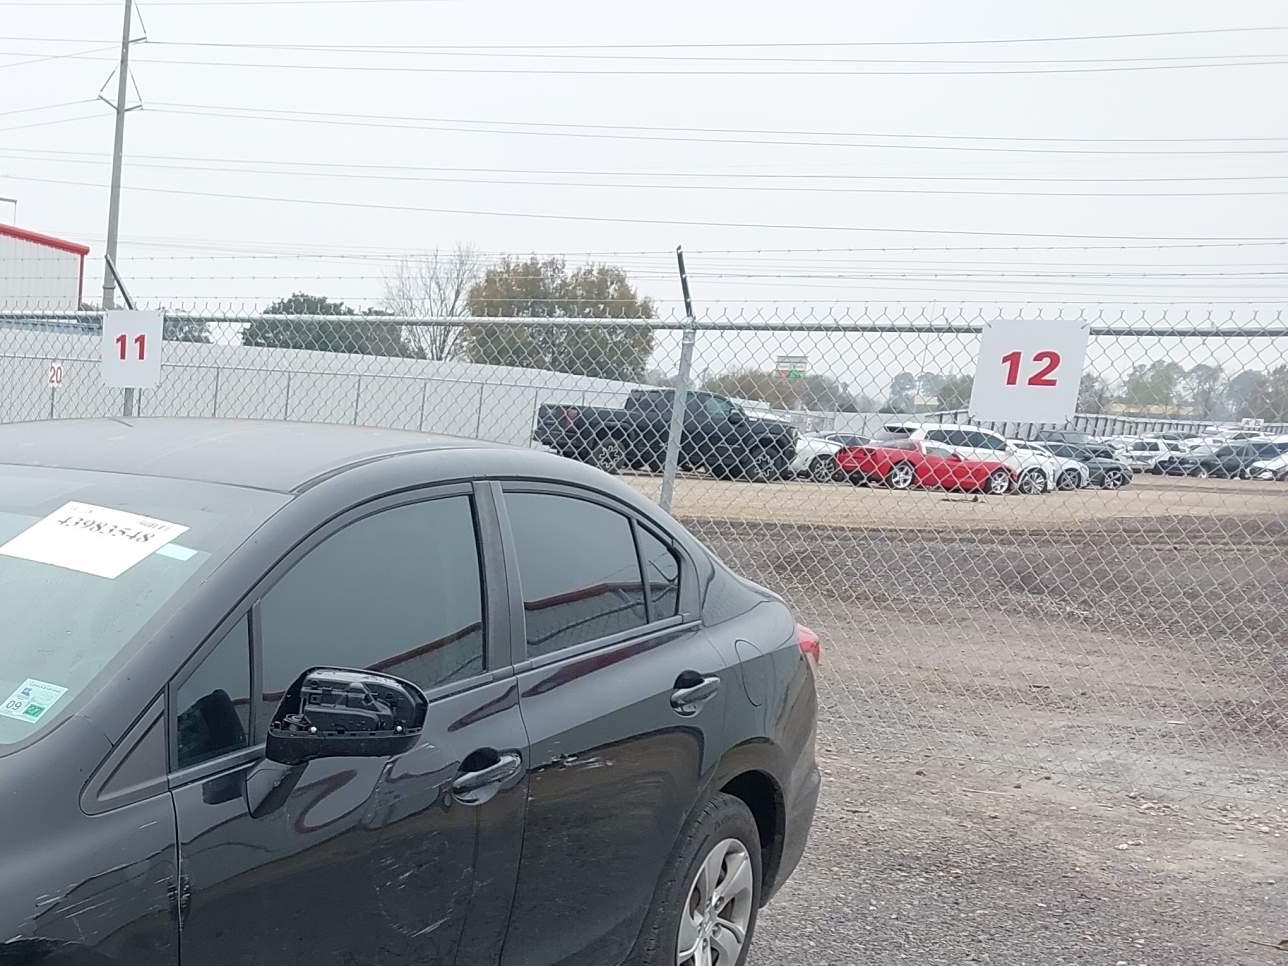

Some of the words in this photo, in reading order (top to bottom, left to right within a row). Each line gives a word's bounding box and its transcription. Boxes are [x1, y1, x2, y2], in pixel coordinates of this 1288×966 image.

[115, 334, 145, 360] 11
[48, 366, 62, 384] 20
[1001, 350, 1060, 387] 12
[57, 515, 156, 543] 43983548
[6, 700, 23, 711] 09
